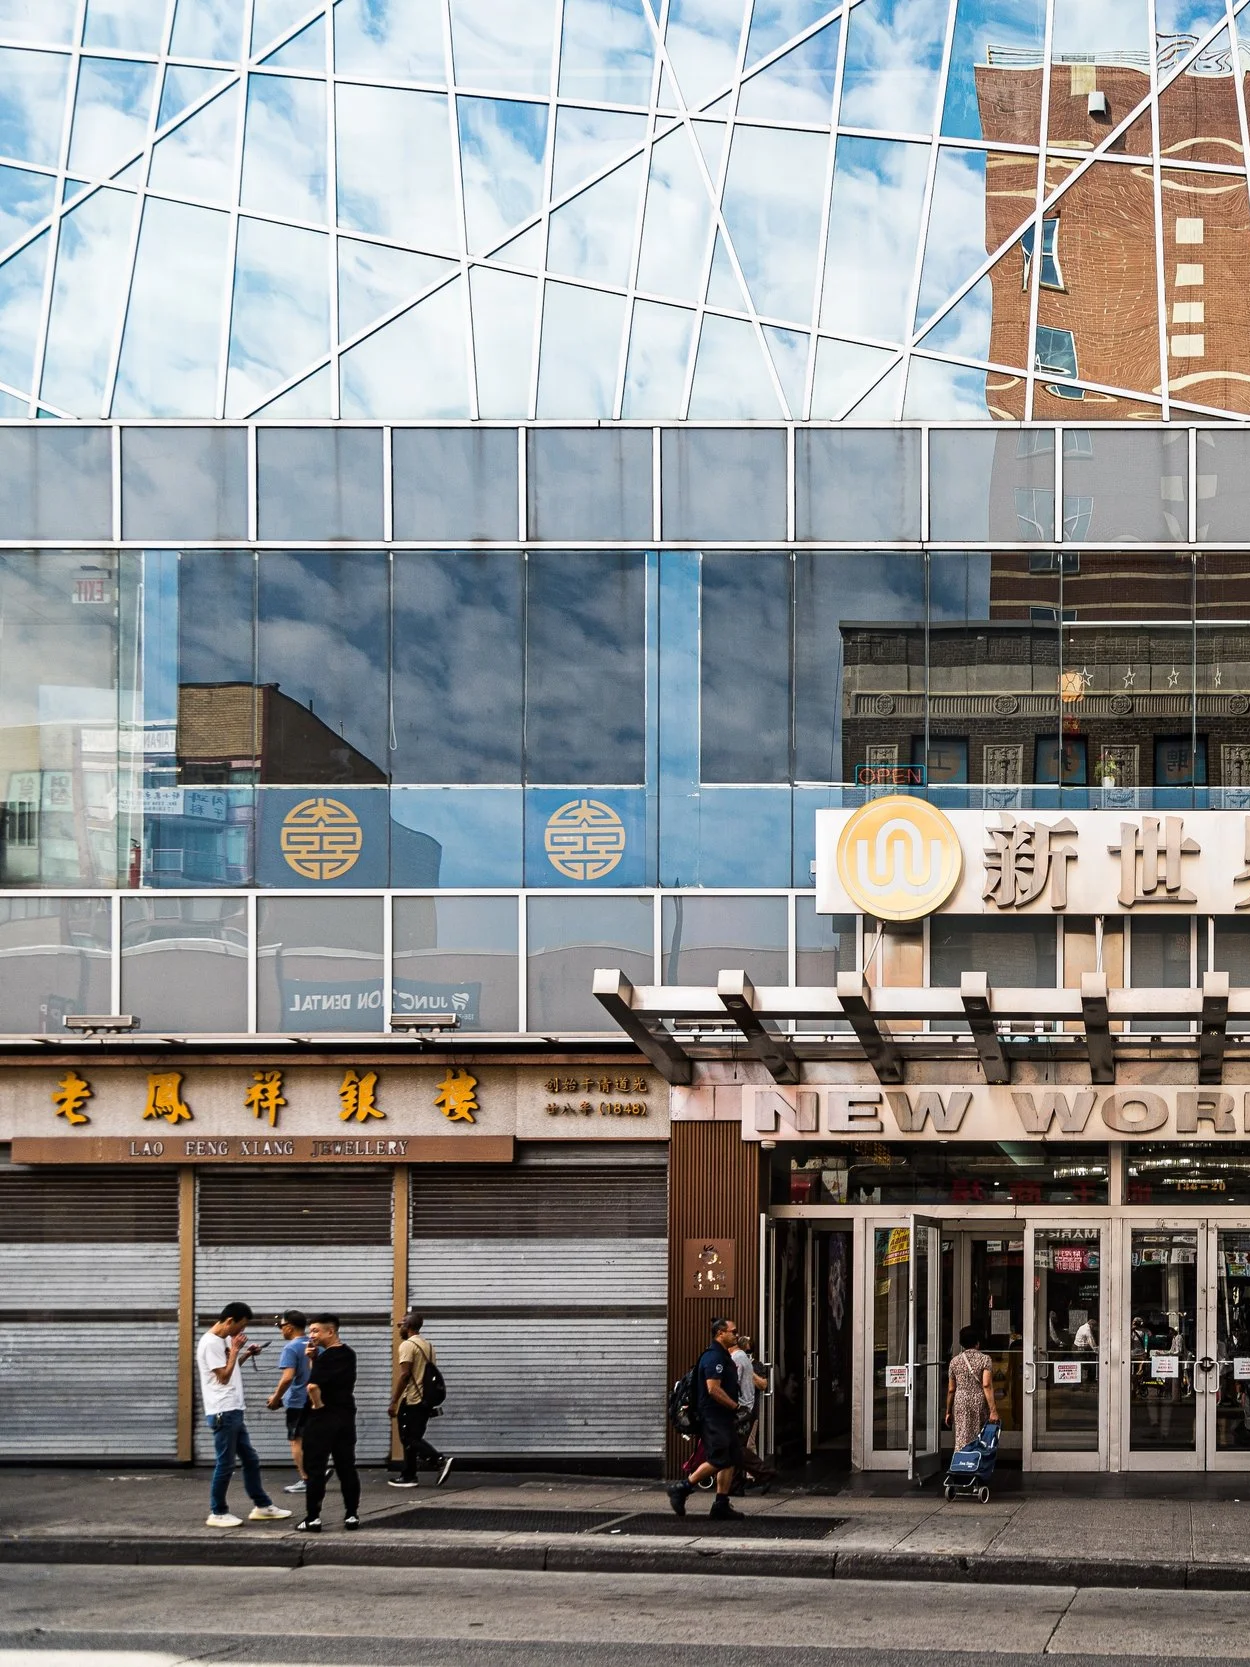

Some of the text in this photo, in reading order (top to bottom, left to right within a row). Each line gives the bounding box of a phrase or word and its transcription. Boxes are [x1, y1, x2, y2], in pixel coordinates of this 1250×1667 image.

[858, 767, 922, 785] OPEN
[51, 1068, 481, 1127] 老鳳祥銀樓
[600, 1101, 648, 1116] (1848)
[754, 1091, 973, 1133] NEW
[129, 1140, 409, 1157] LAO FENG XIANG JEWELLERY
